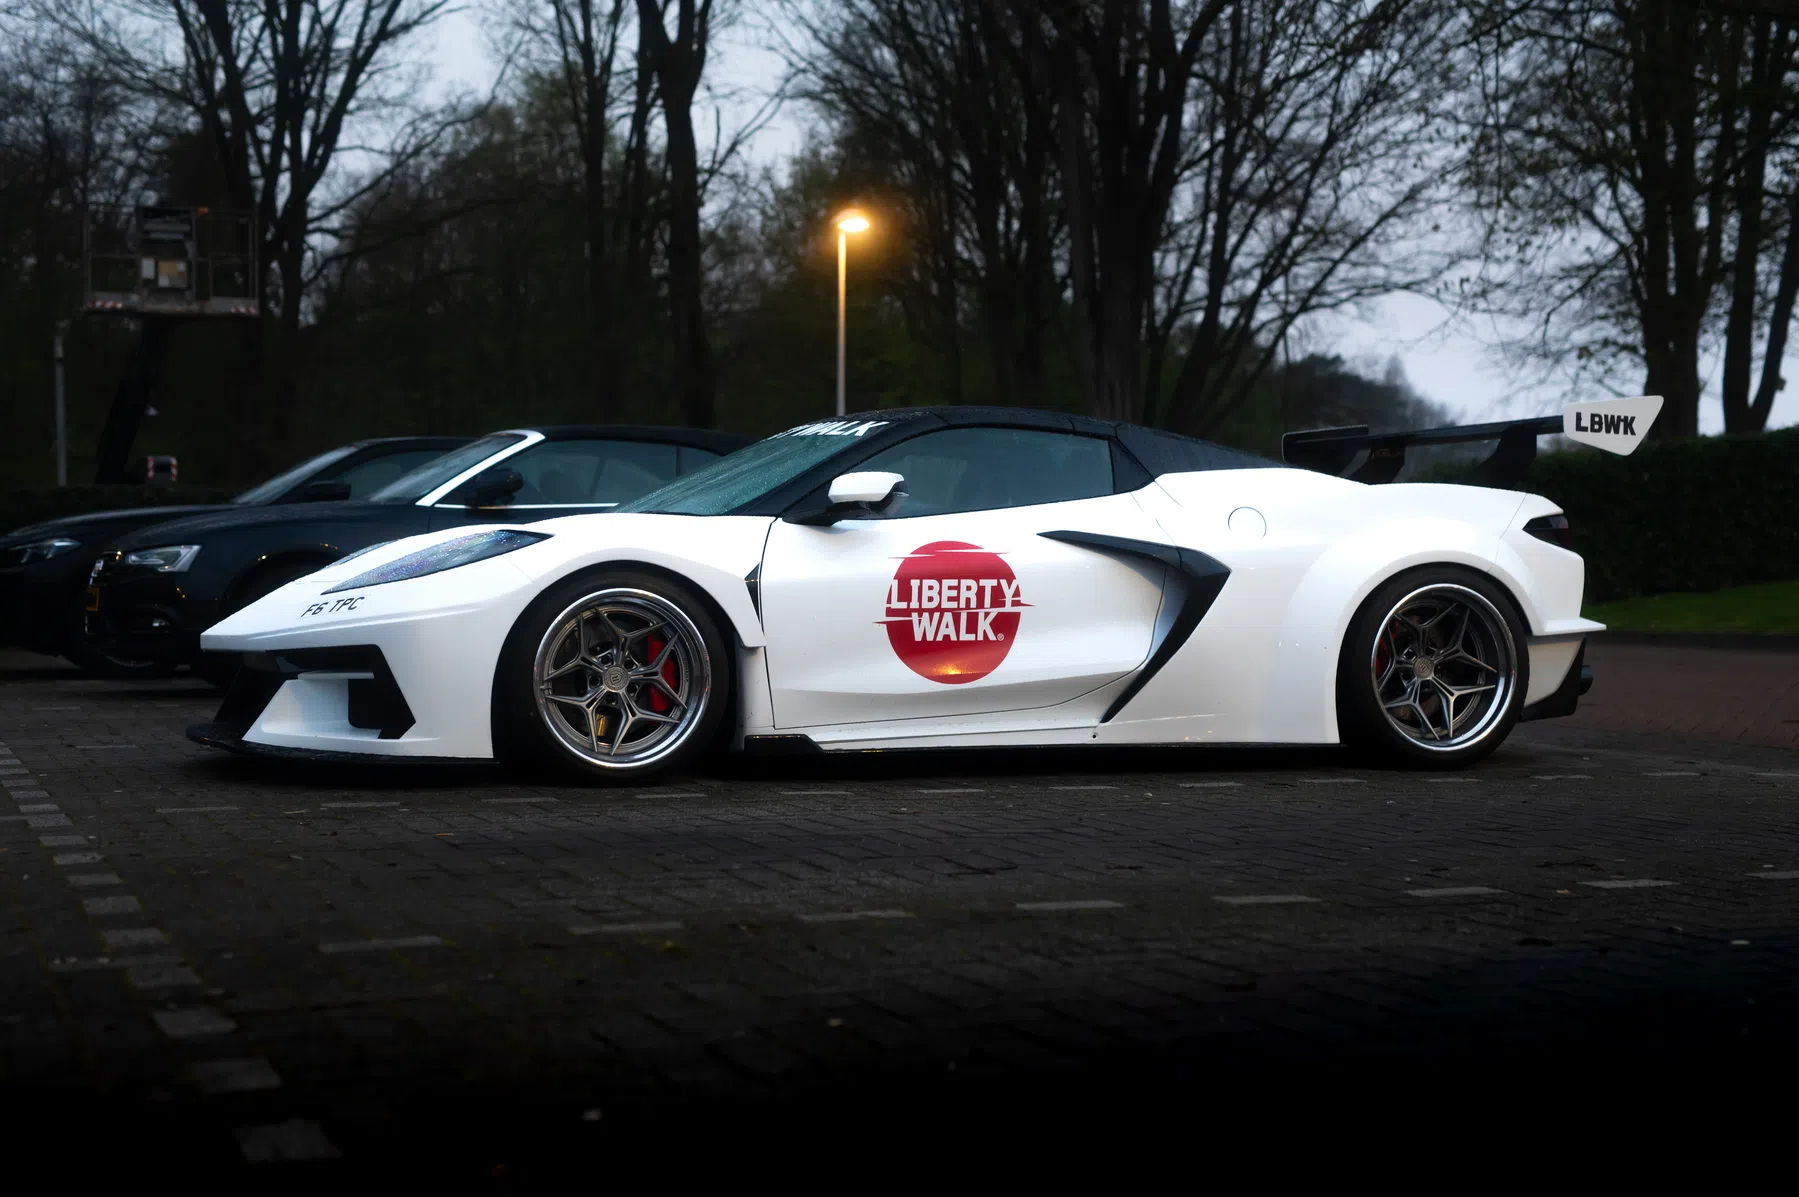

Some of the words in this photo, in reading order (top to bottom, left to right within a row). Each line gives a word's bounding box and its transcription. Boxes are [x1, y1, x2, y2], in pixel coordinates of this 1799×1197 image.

[1575, 411, 1637, 436] LBWK
[300, 602, 329, 617] F6
[329, 596, 365, 613] TPC
[890, 578, 1017, 610] LIBERTY
[911, 611, 998, 642] WALK
